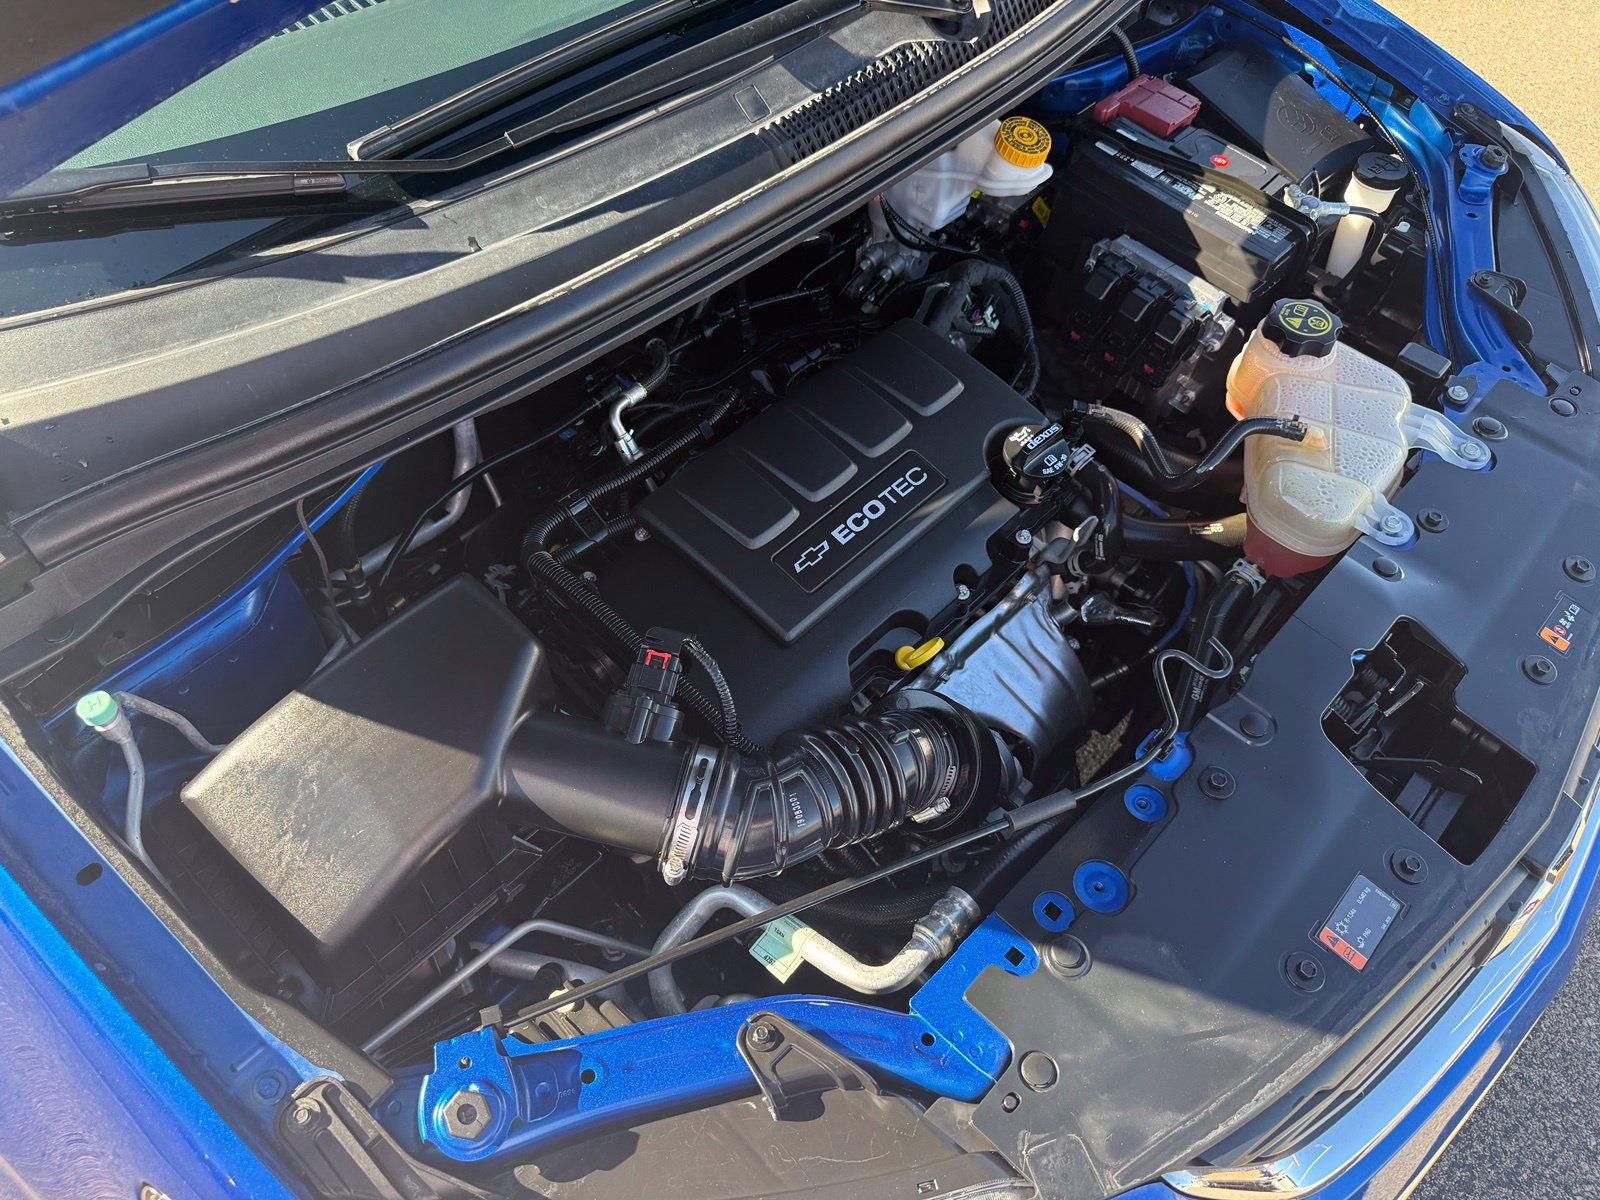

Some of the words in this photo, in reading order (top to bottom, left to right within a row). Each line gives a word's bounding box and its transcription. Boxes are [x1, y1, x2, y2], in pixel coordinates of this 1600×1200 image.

[1026, 426, 1060, 450] dexos
[1042, 467, 1055, 475] SAE
[830, 467, 928, 545] ECOTEC
[1191, 686, 1201, 701] GM
[1343, 908, 1357, 924] R-134a
[1362, 927, 1372, 938] PAG
